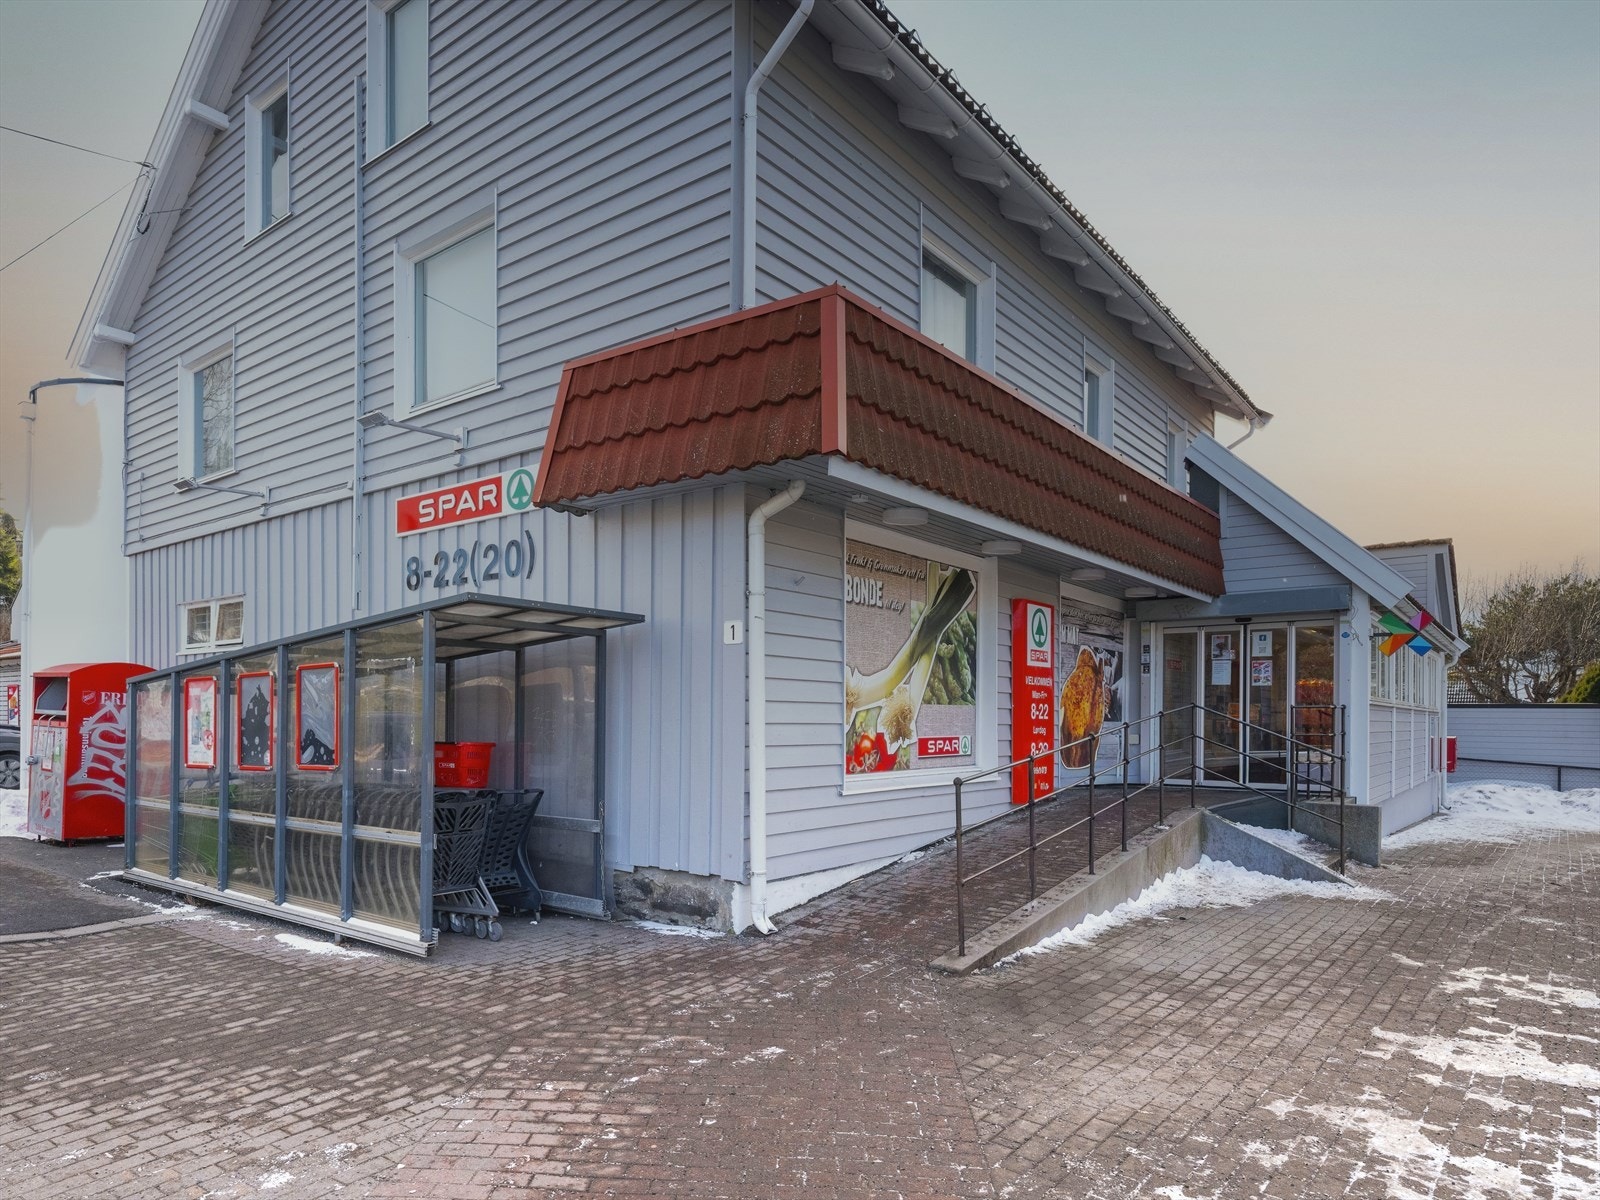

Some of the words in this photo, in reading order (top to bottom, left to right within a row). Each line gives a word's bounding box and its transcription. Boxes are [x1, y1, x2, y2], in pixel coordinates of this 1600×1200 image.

[418, 484, 498, 524] SPAR
[406, 529, 536, 592] 8-22(20)
[845, 573, 884, 608] BONDE
[730, 624, 735, 641] 1
[1031, 650, 1048, 662] SPAR
[1030, 703, 1049, 720] 8-22
[927, 739, 960, 753] SPAR
